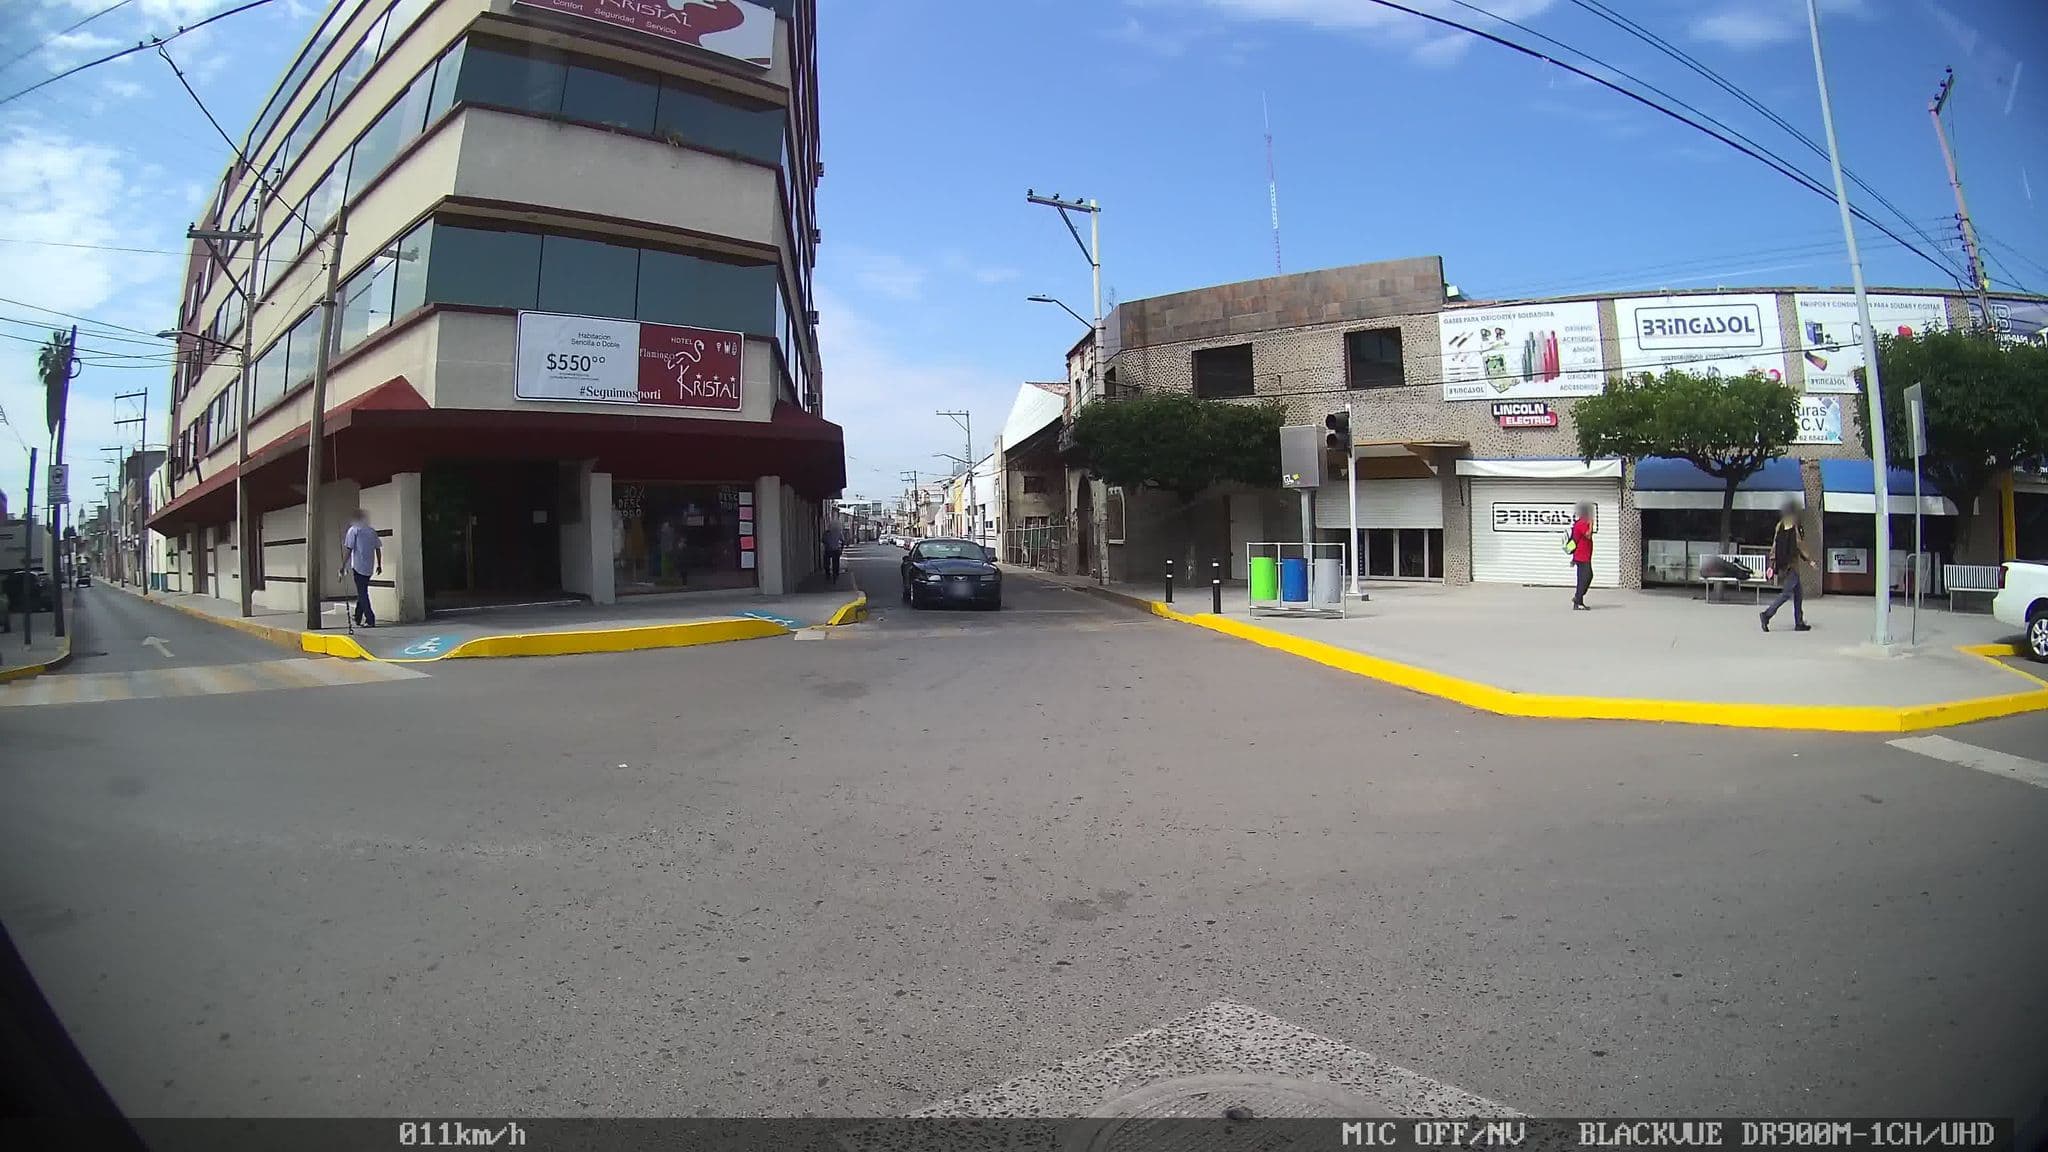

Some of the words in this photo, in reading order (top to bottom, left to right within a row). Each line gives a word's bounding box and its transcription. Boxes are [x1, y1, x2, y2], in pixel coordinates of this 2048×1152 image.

[553, 0, 584, 11] Confort
[594, 8, 635, 24] Seguridad
[646, 21, 677, 35] Servicio
[600, 0, 692, 27] RISTAL
[671, 336, 693, 345] HOTEL
[677, 364, 739, 400] KRISTAL
[1493, 403, 1545, 415] LINCOLN
[1797, 406, 1827, 417] uras
[1506, 415, 1551, 425] ELECTRIC
[1801, 417, 1828, 431] C.V.
[1496, 510, 1577, 525] BRINGAS
